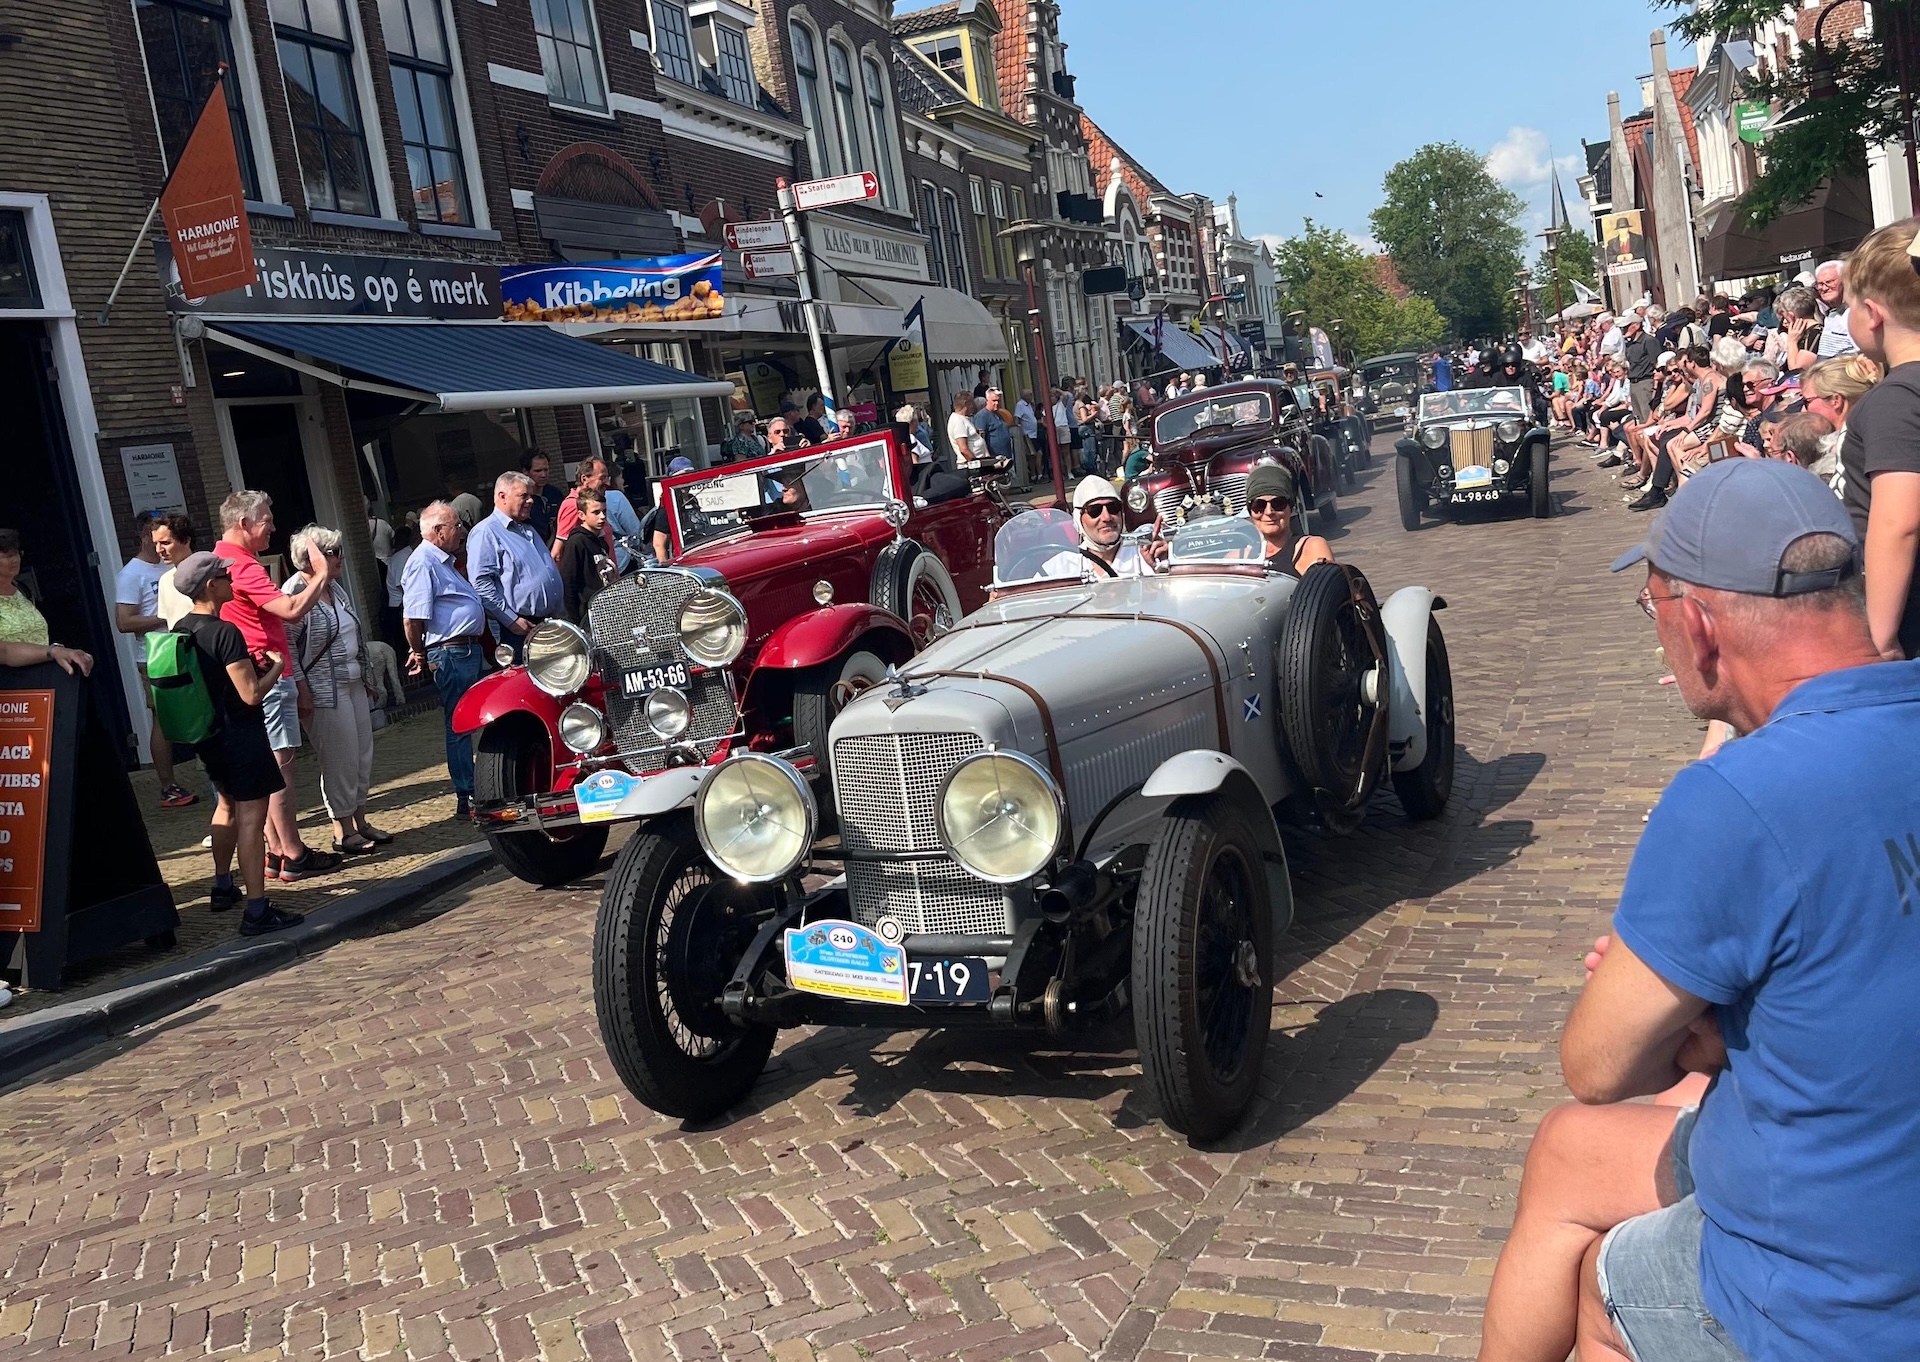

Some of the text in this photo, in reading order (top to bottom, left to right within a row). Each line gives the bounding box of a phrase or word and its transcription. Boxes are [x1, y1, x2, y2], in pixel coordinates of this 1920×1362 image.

[808, 183, 836, 193] Station
[177, 215, 240, 242] HARMONIE
[823, 228, 852, 255] KAAS
[872, 239, 919, 266] HARMONIE
[1779, 250, 1812, 263] Restaurant
[364, 275, 398, 313] op
[407, 268, 423, 304] é
[429, 271, 489, 306] merk
[544, 276, 682, 310] Kibbeling
[132, 452, 165, 461] HARMONIE
[1451, 490, 1499, 504] AL-98-68
[710, 516, 729, 526] Klein
[625, 663, 686, 694] AM-53-66
[0, 702, 29, 714] ONIE
[833, 934, 853, 944] 240
[908, 962, 970, 996] 7-19
